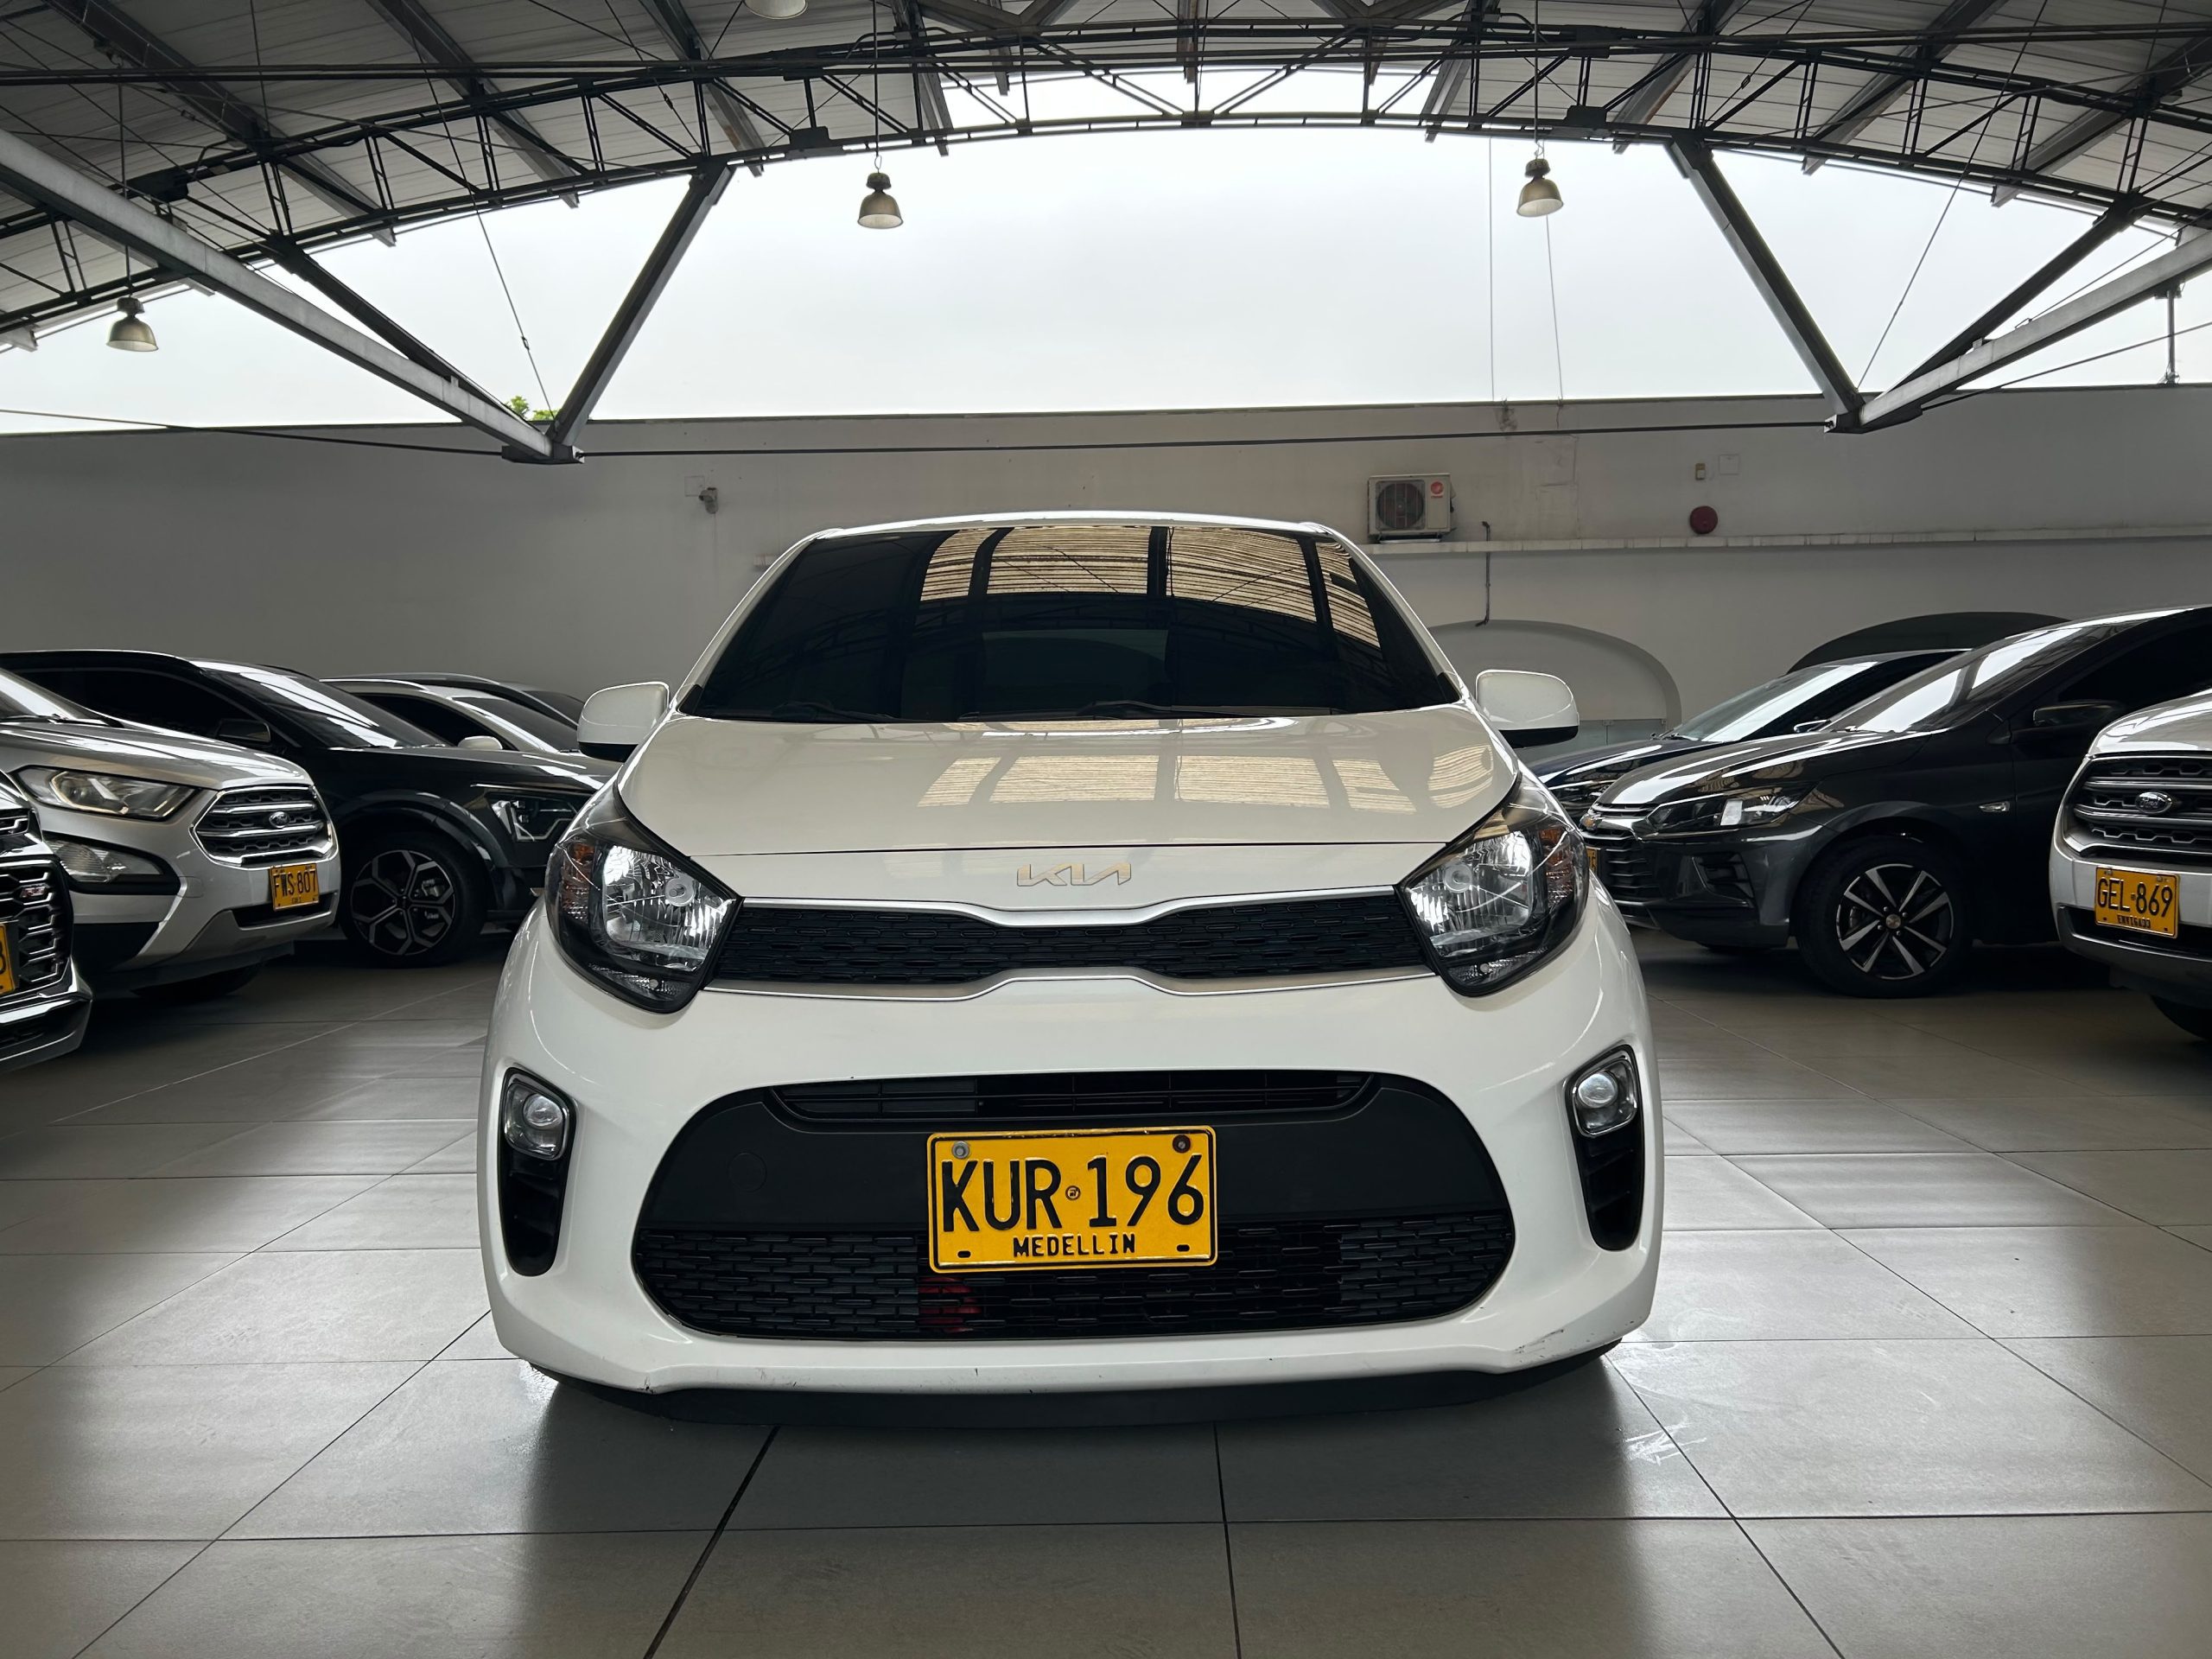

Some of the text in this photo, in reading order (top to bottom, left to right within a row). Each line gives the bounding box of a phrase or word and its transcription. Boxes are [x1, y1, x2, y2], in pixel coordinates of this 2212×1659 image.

[297, 869, 316, 894] 807
[2098, 877, 2173, 918] GEL 869
[941, 1154, 1205, 1232] KUR 196
[1013, 1232, 1135, 1257] MEDELLIN
